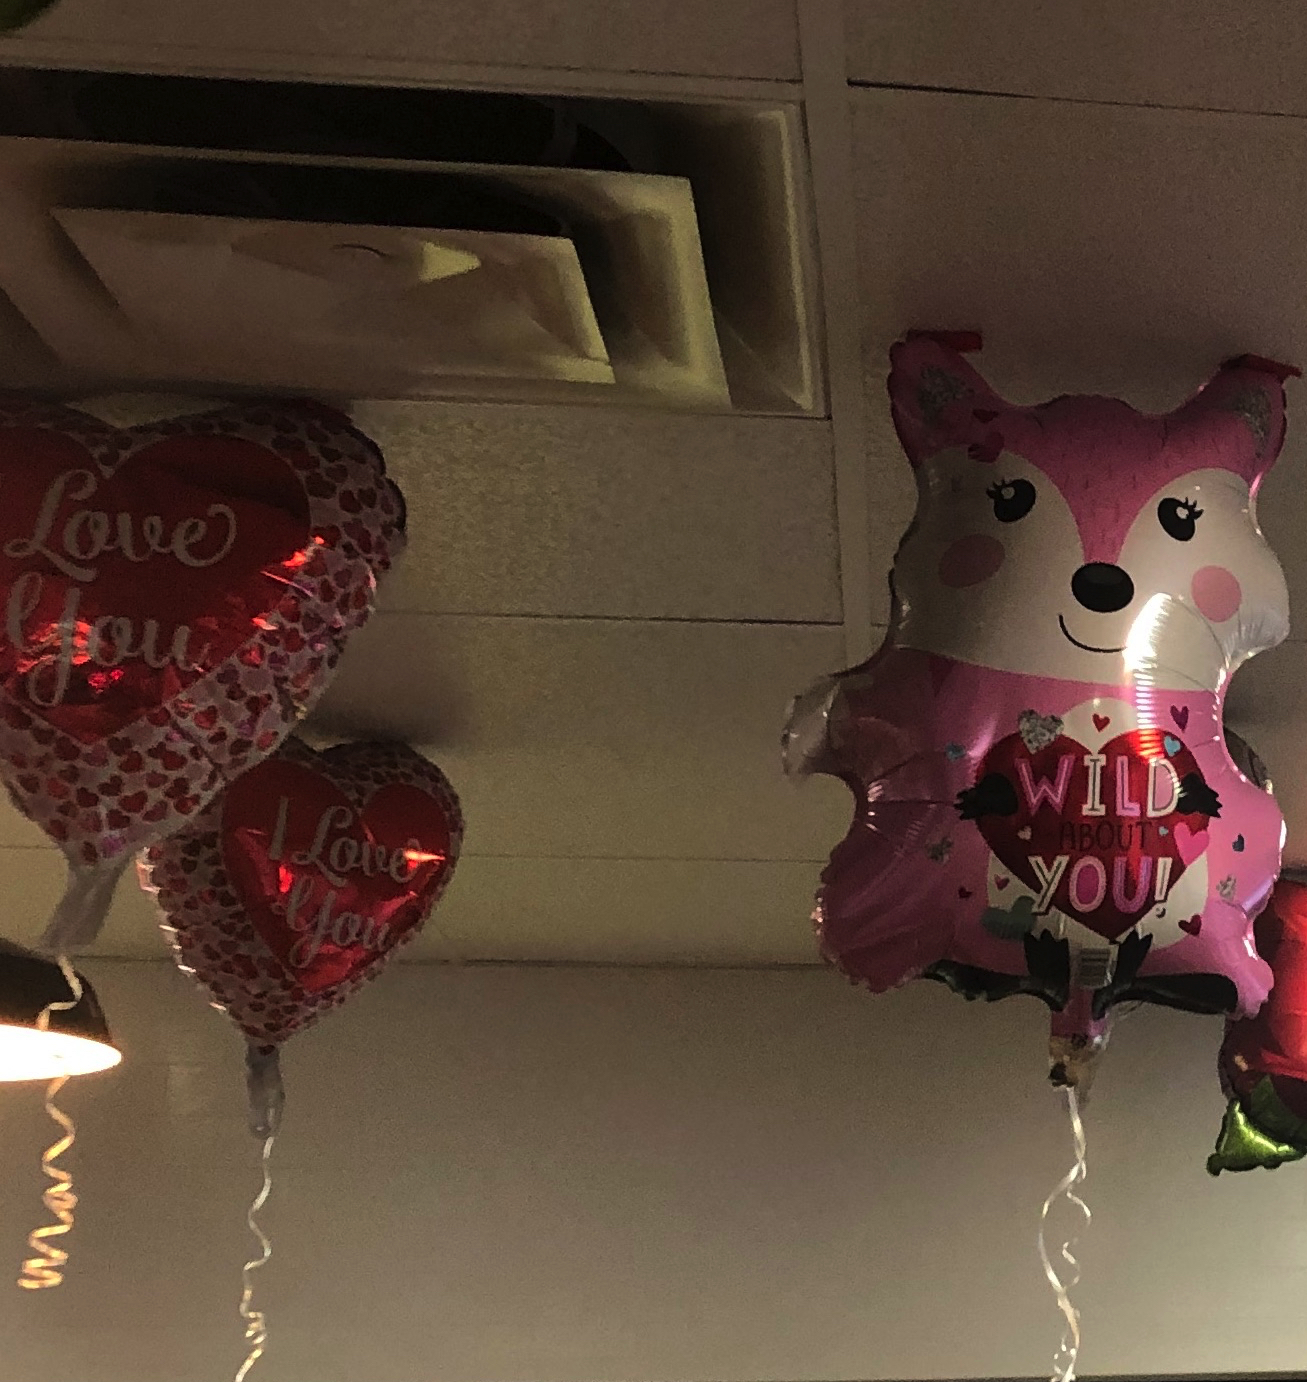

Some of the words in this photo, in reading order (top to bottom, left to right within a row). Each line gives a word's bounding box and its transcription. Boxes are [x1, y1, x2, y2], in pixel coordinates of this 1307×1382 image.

[3, 469, 238, 582] Love
[4, 571, 206, 708] You
[1014, 753, 1179, 818] WILD
[269, 797, 290, 861] I
[290, 804, 421, 887] Love
[1060, 820, 1153, 851] ABOUT
[271, 875, 391, 970] You
[1027, 854, 1173, 919] YOU!
